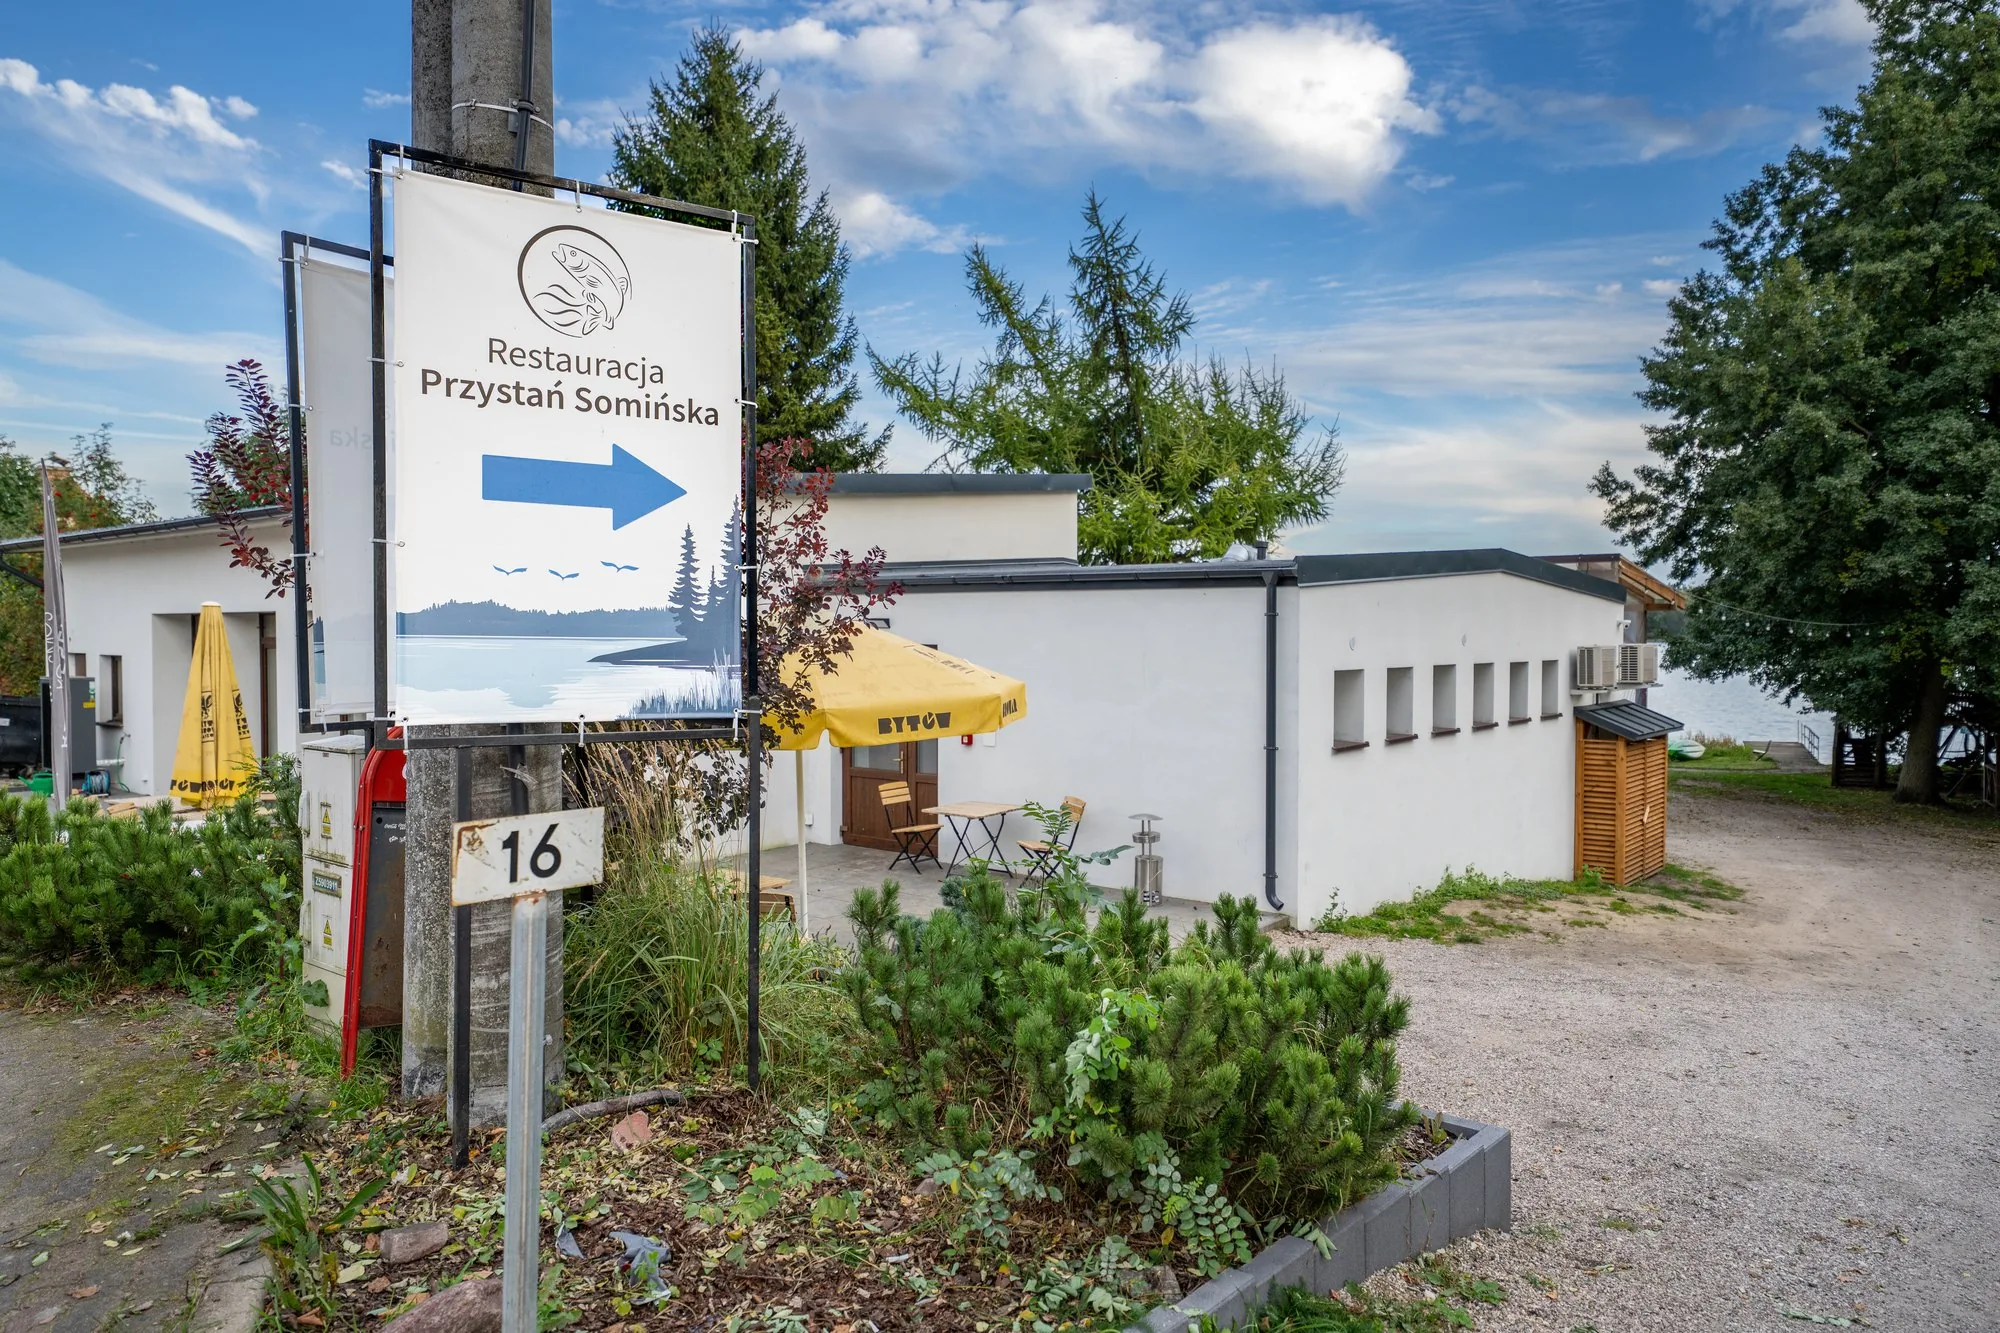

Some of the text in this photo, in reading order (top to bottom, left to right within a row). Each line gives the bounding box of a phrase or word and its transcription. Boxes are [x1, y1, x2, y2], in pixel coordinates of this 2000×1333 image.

[488, 337, 664, 389] Restauracja
[421, 368, 719, 426] Przystań Somińska
[502, 823, 562, 883] 16
